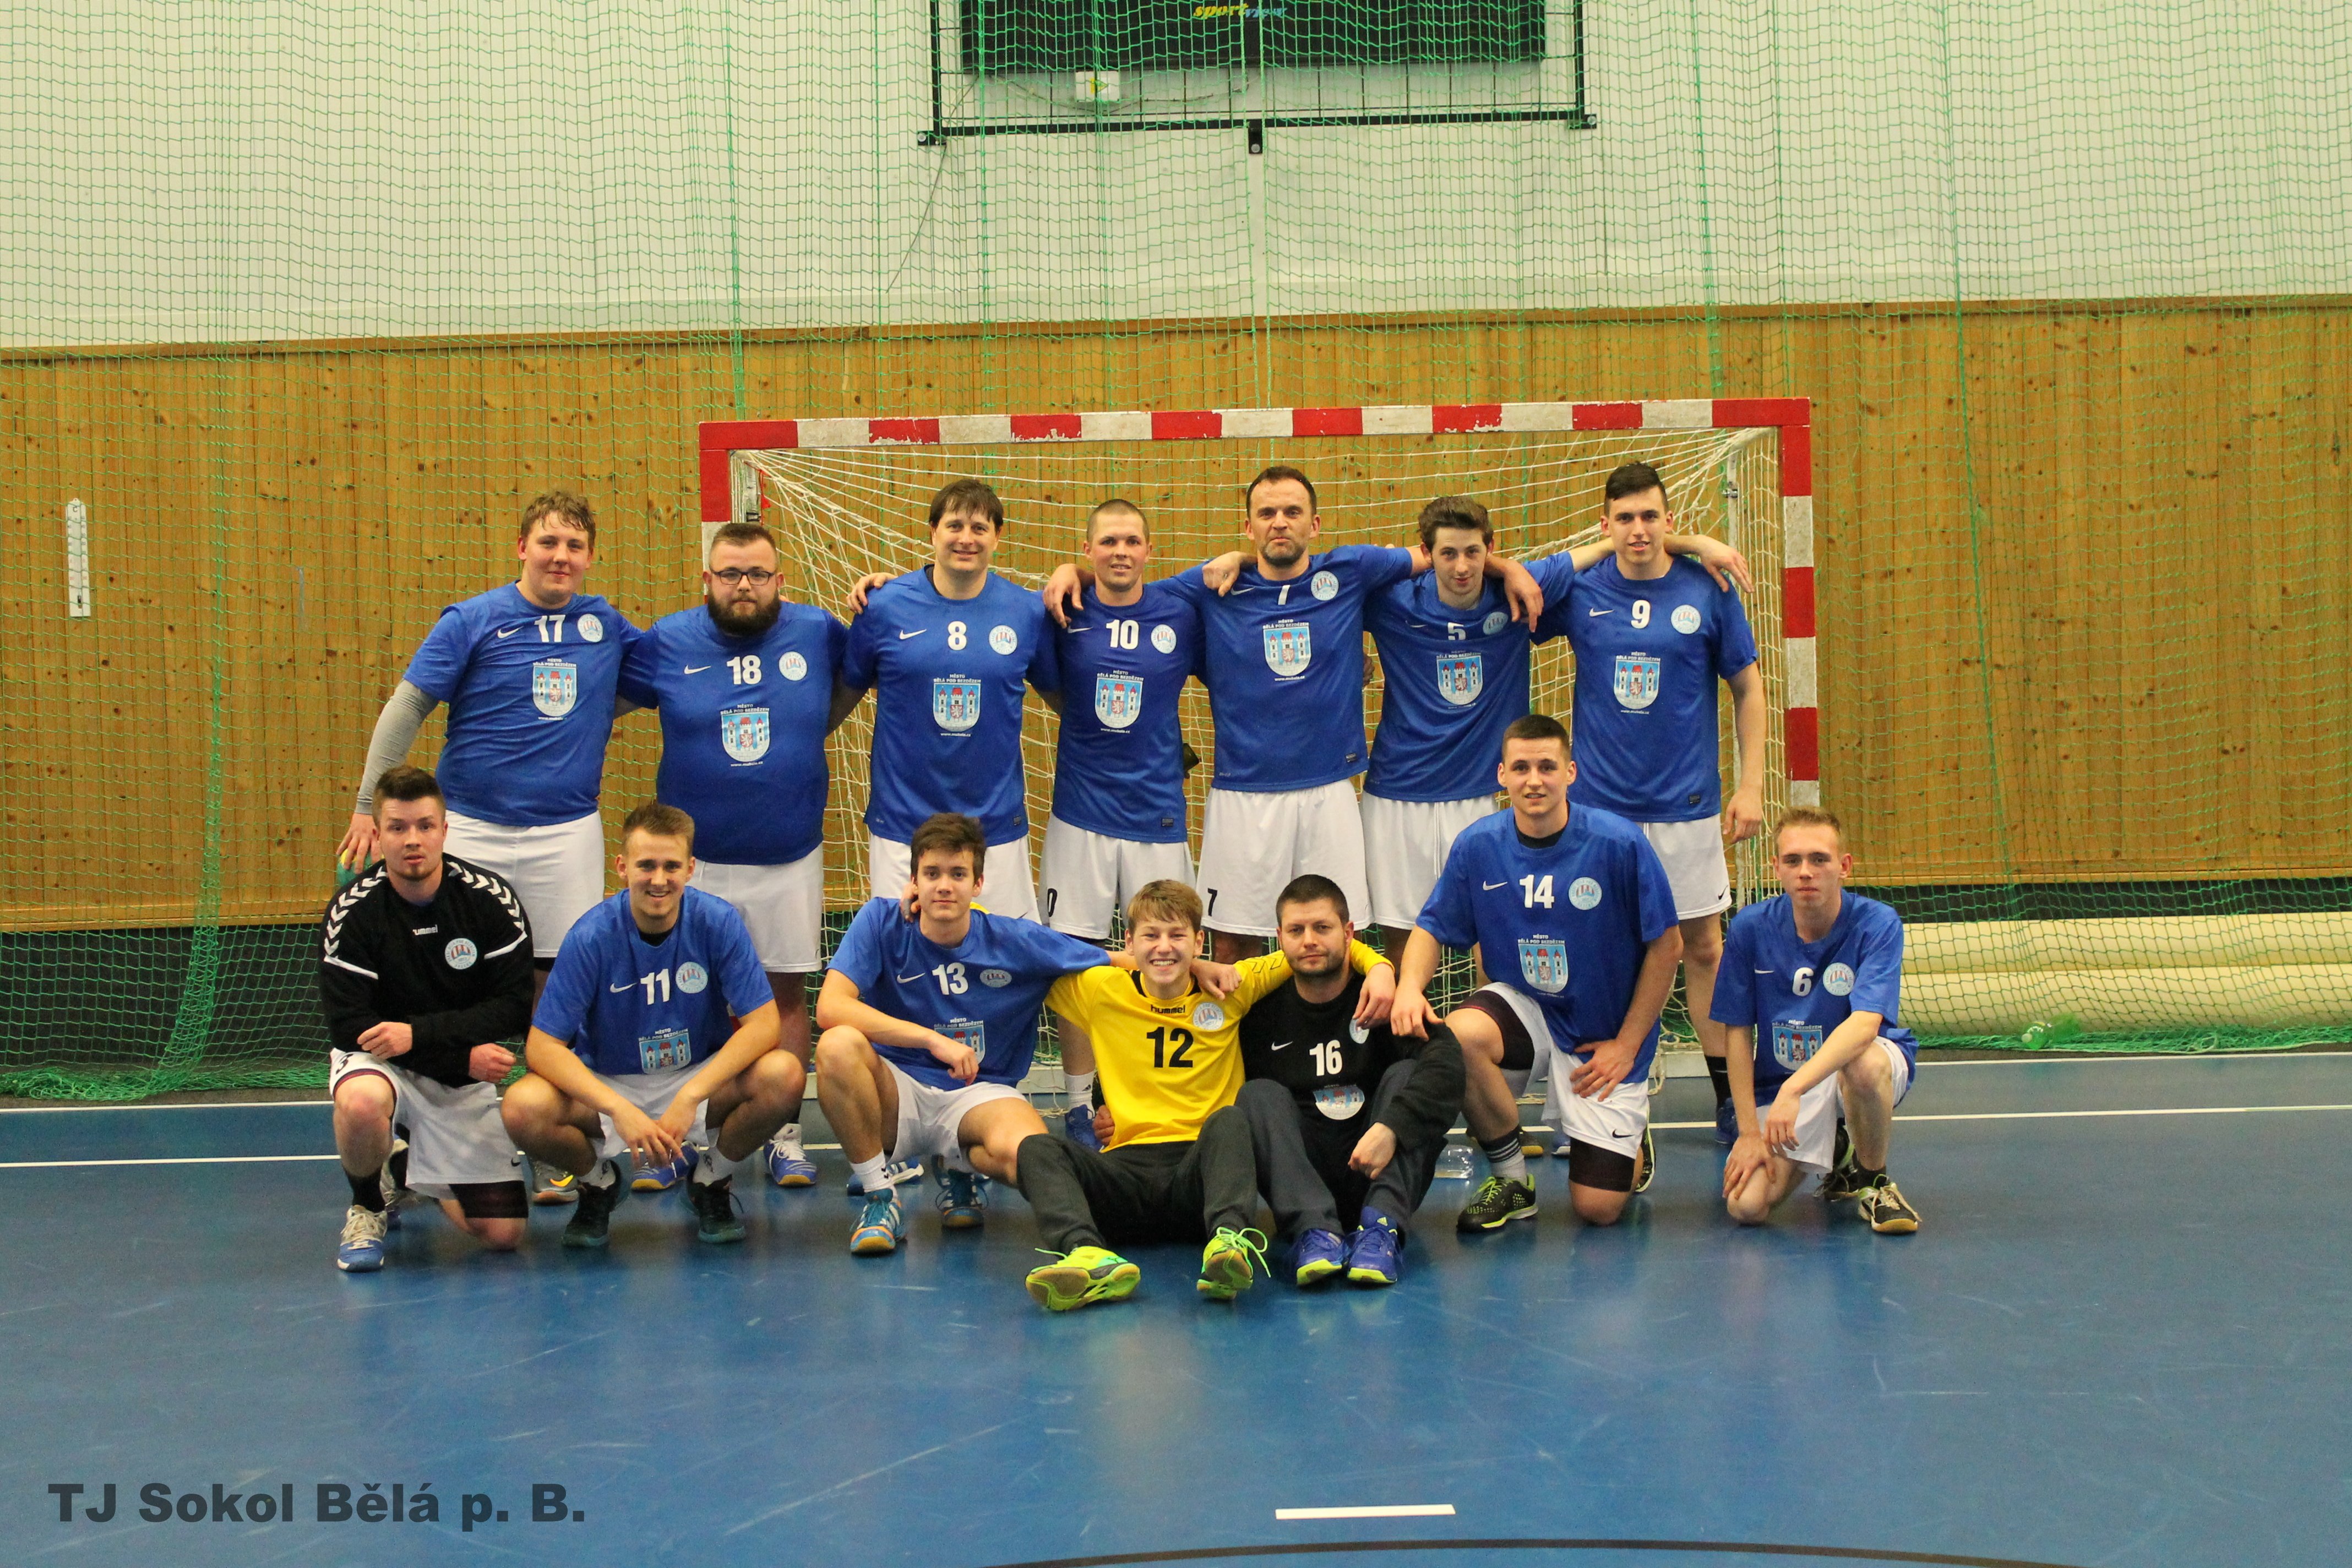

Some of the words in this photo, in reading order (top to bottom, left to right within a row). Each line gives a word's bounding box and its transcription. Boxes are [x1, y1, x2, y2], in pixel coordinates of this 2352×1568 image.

[535, 614, 565, 643] 17
[1631, 600, 1651, 629] 9
[947, 620, 967, 650] 8
[1106, 619, 1139, 650] 10
[1447, 622, 1466, 641] 5
[726, 655, 762, 685] 18
[1207, 888, 1218, 917] 7
[1519, 874, 1555, 909] 14
[413, 924, 438, 935] ummel
[640, 968, 670, 1005] 11
[932, 962, 969, 995] 13
[1792, 967, 1814, 997] 6
[1151, 1004, 1185, 1014] hummel
[1146, 1026, 1194, 1068] 12
[1309, 1039, 1343, 1076] 16
